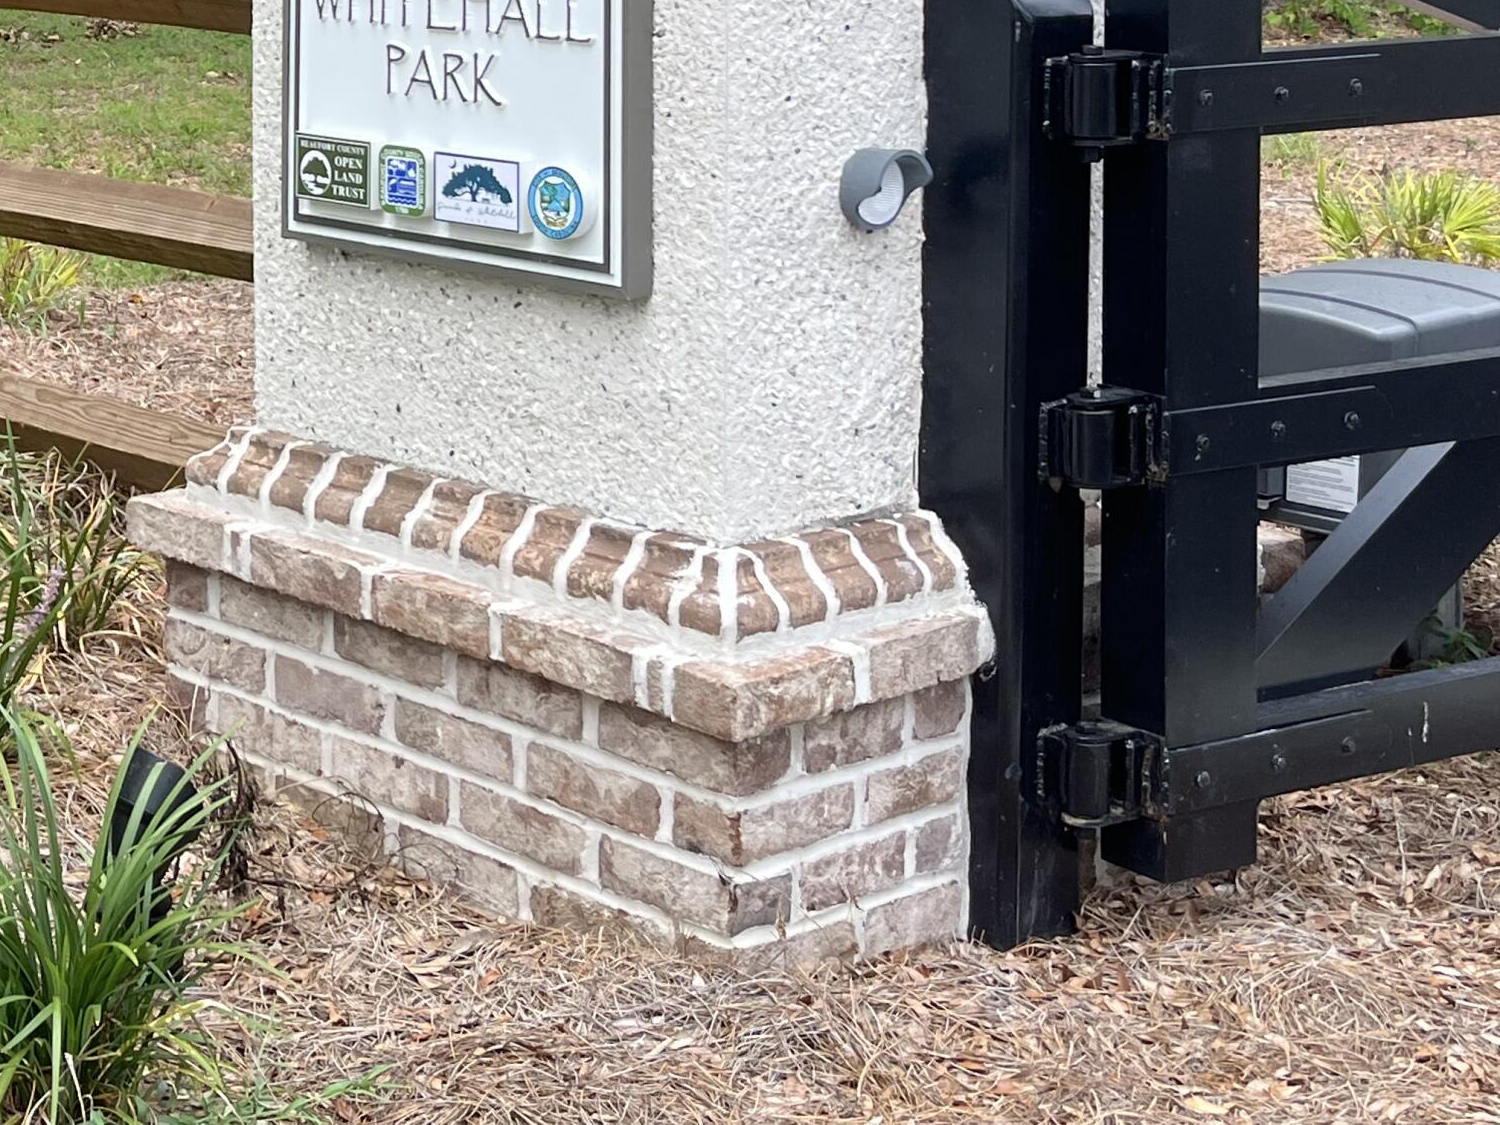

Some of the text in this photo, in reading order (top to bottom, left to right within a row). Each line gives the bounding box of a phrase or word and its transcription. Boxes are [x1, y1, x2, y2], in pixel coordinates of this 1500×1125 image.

[385, 43, 505, 107] PARK
[336, 143, 365, 156] COUNTY
[334, 155, 363, 170] OPEN
[334, 169, 363, 185] LAND
[331, 184, 366, 200] TRUST
